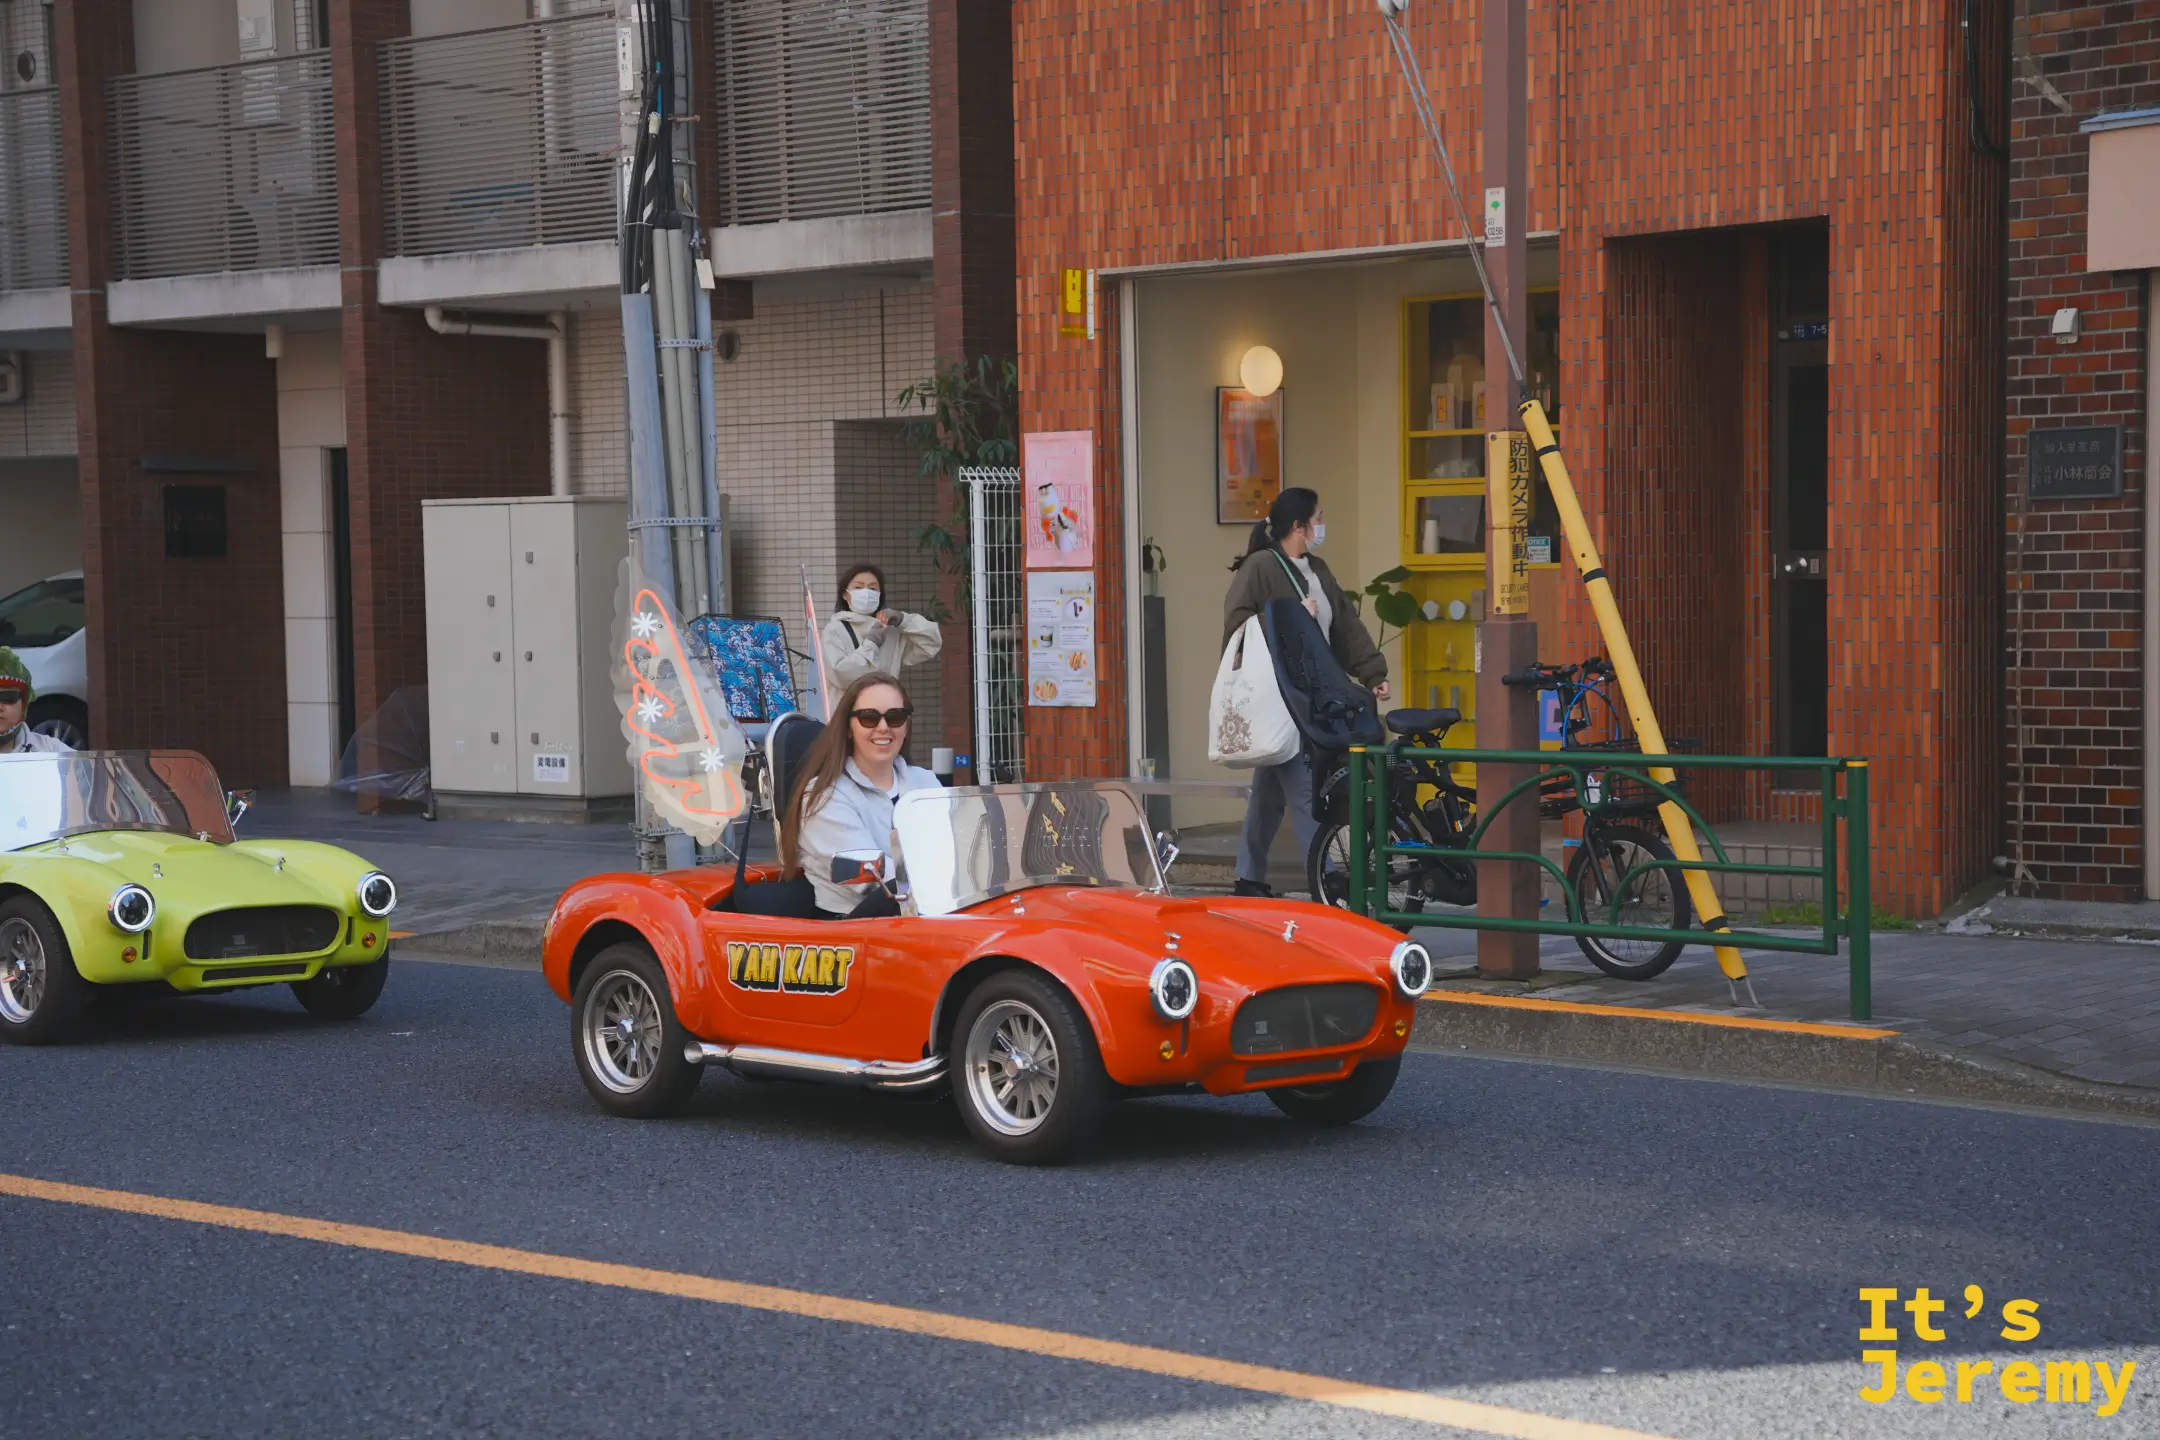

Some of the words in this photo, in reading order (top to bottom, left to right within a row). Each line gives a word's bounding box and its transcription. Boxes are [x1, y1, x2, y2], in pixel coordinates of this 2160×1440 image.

[1811, 325, 1827, 335] 7-5
[1509, 439, 1529, 577] 防犯カメラ作動中
[955, 756, 967, 766] 7-6
[728, 943, 780, 991] YAH
[783, 945, 854, 994] KART
